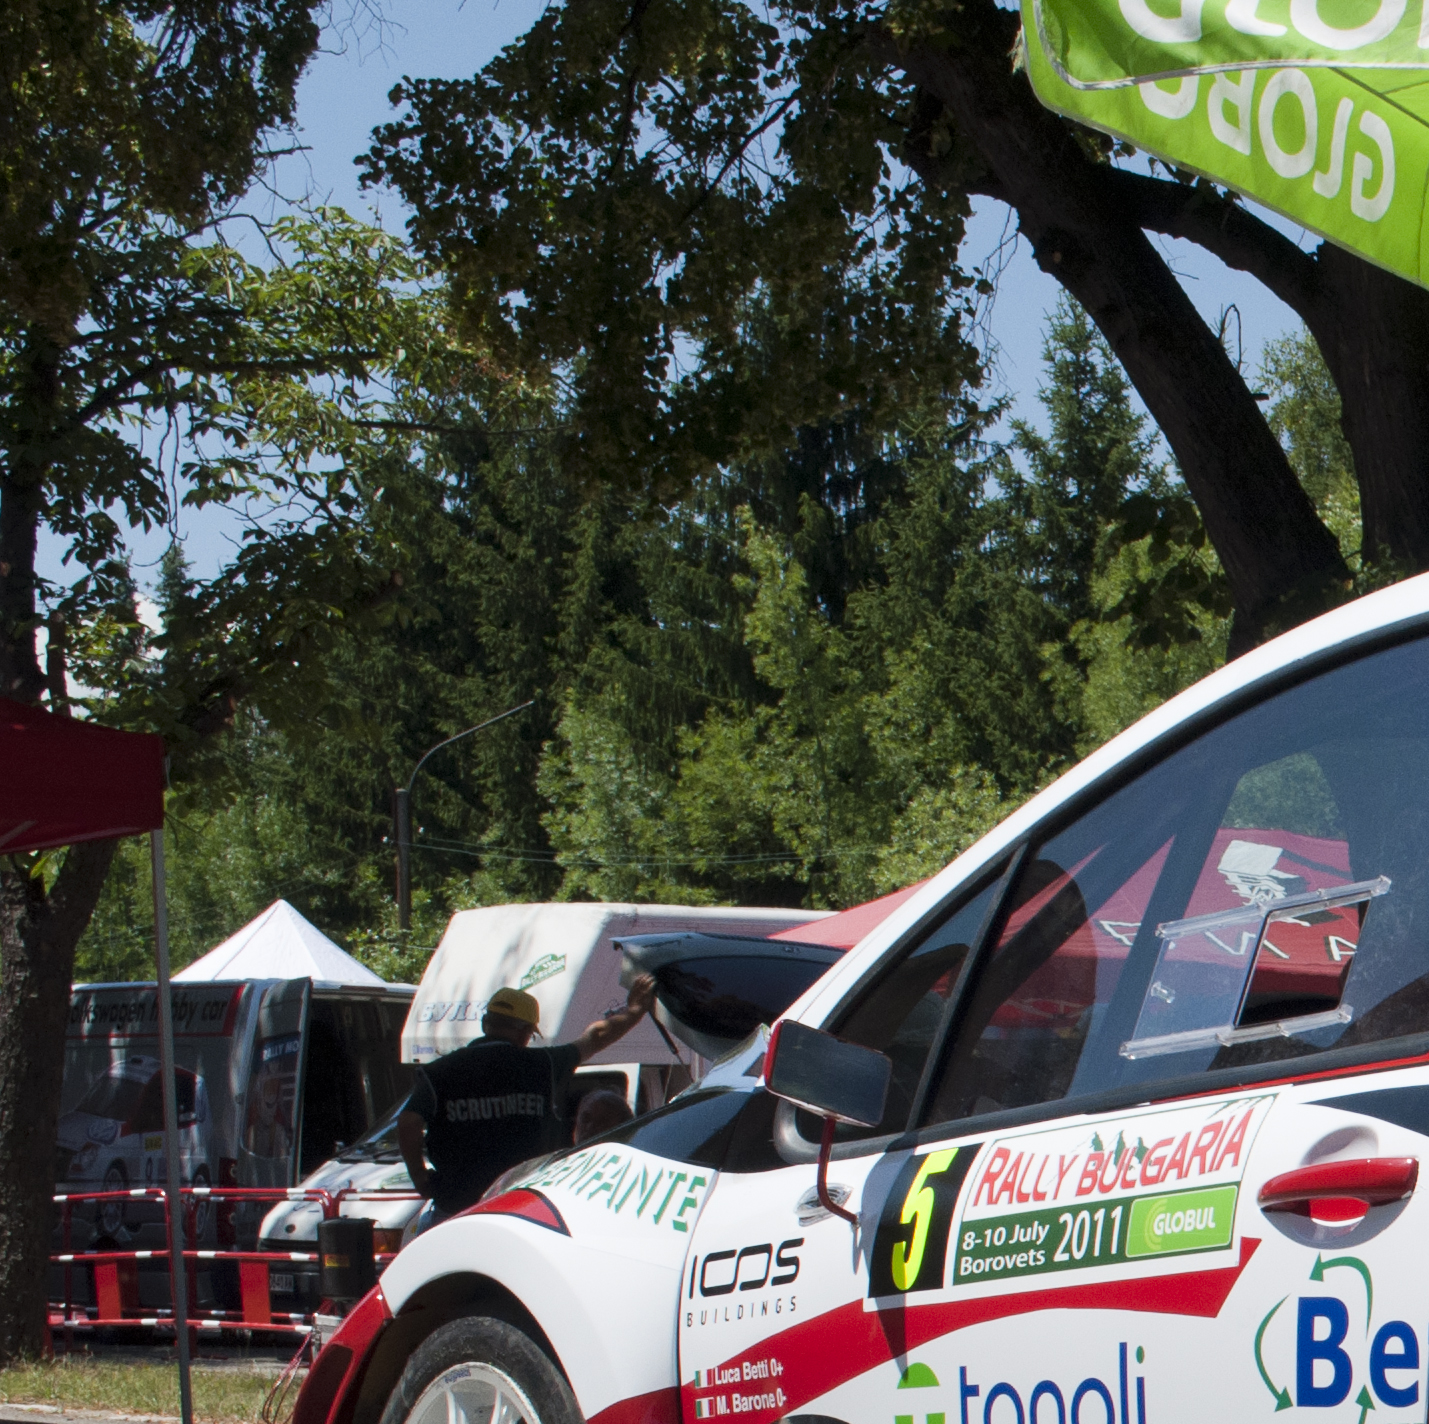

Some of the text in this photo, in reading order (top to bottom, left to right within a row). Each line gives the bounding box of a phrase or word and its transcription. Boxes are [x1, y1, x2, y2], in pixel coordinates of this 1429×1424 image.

[973, 1109, 1254, 1207] RALLY BULGARIA
[891, 1147, 959, 1291] 5
[961, 1219, 1051, 1252] 8-10 July
[1054, 1204, 1217, 1264] 2011 GLOBUL
[959, 1248, 1047, 1277] Borovets
[687, 1295, 799, 1329] BUILDINGS
[715, 1366, 741, 1385] Luca
[742, 1359, 769, 1381] Betti
[716, 1394, 731, 1415] M.
[732, 1393, 776, 1413] Barone
